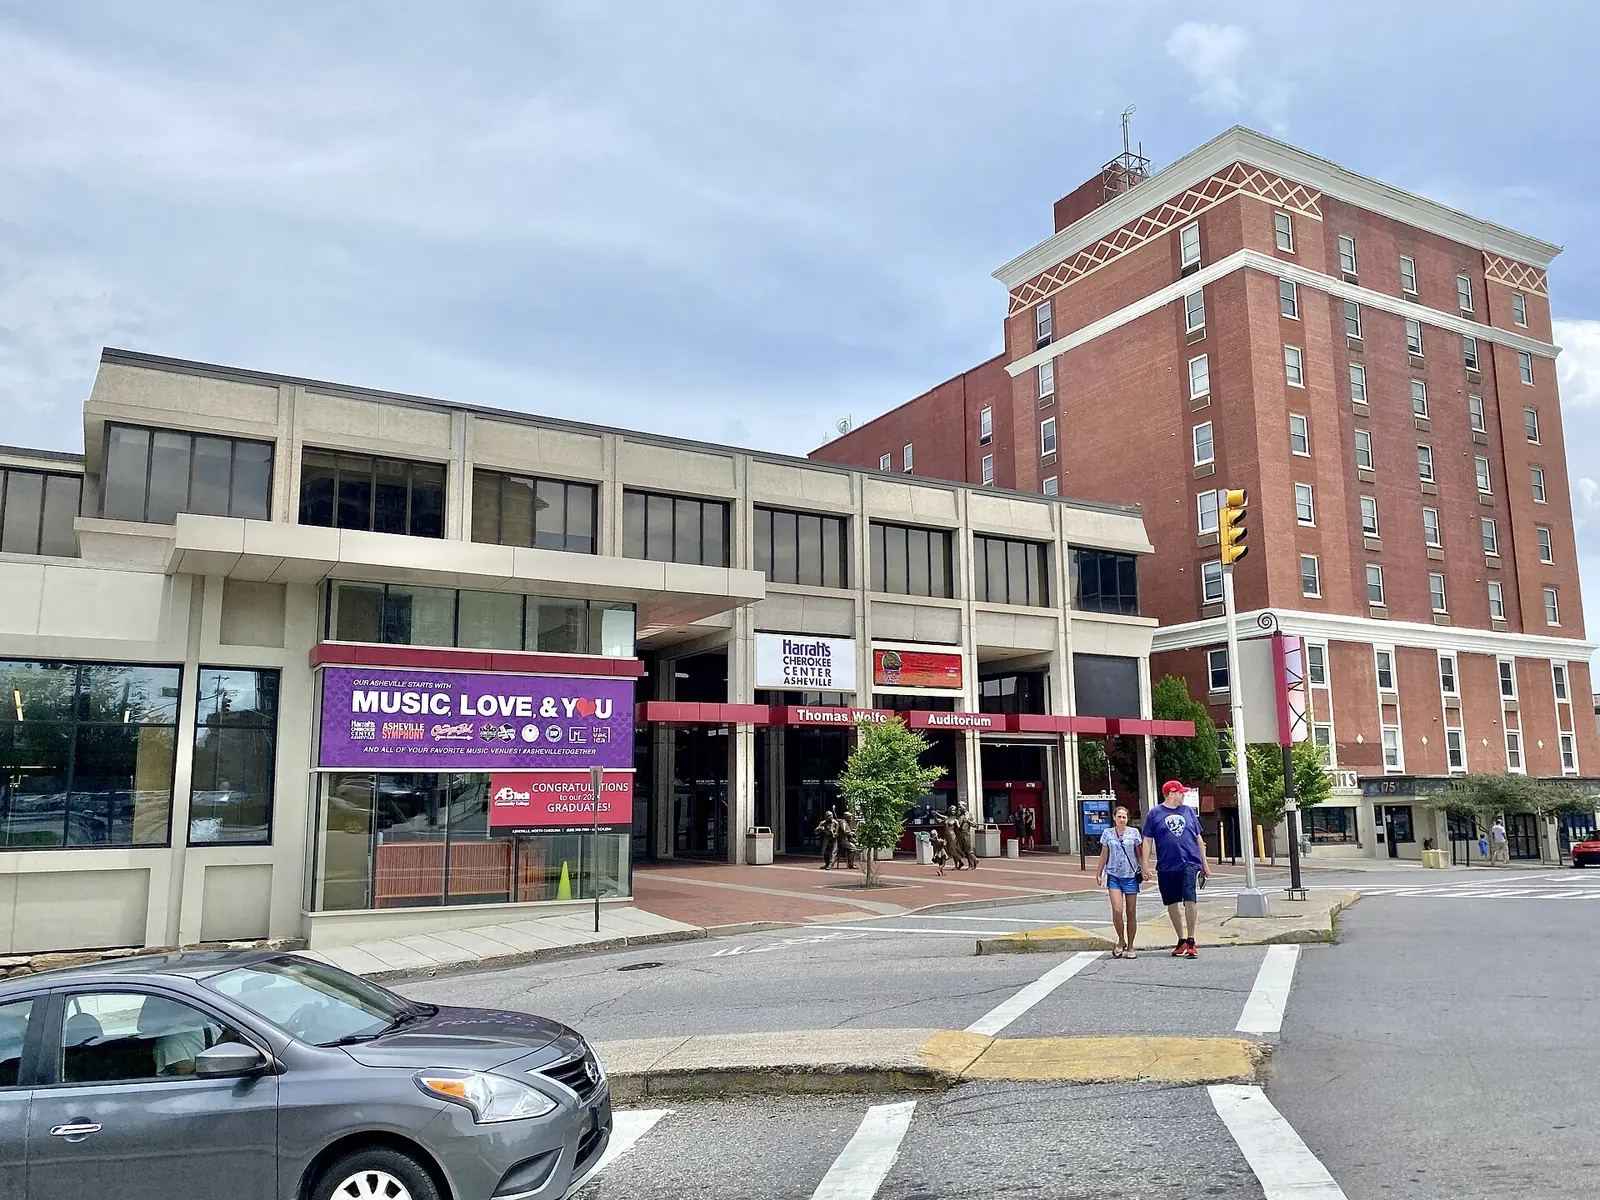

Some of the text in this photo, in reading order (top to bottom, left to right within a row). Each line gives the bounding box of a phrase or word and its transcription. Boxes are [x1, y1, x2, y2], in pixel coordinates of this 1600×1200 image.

[783, 639, 831, 657] Harrah's
[783, 656, 831, 667] CHEROKEE
[783, 666, 831, 677] CENTER
[369, 680, 407, 688] ASHEVILLE
[783, 677, 832, 686] ASHEVILLE
[352, 690, 452, 717] MUSIC,
[460, 693, 537, 719] LOVE,
[539, 696, 559, 718] &
[796, 709, 848, 722] Thomas
[928, 714, 991, 727] Auditorium
[383, 722, 425, 731] ASHEVILLE
[382, 729, 425, 740] SYMPHONY
[532, 782, 629, 792] CONGRATULTIONS
[547, 802, 611, 813] GRADUATES!
